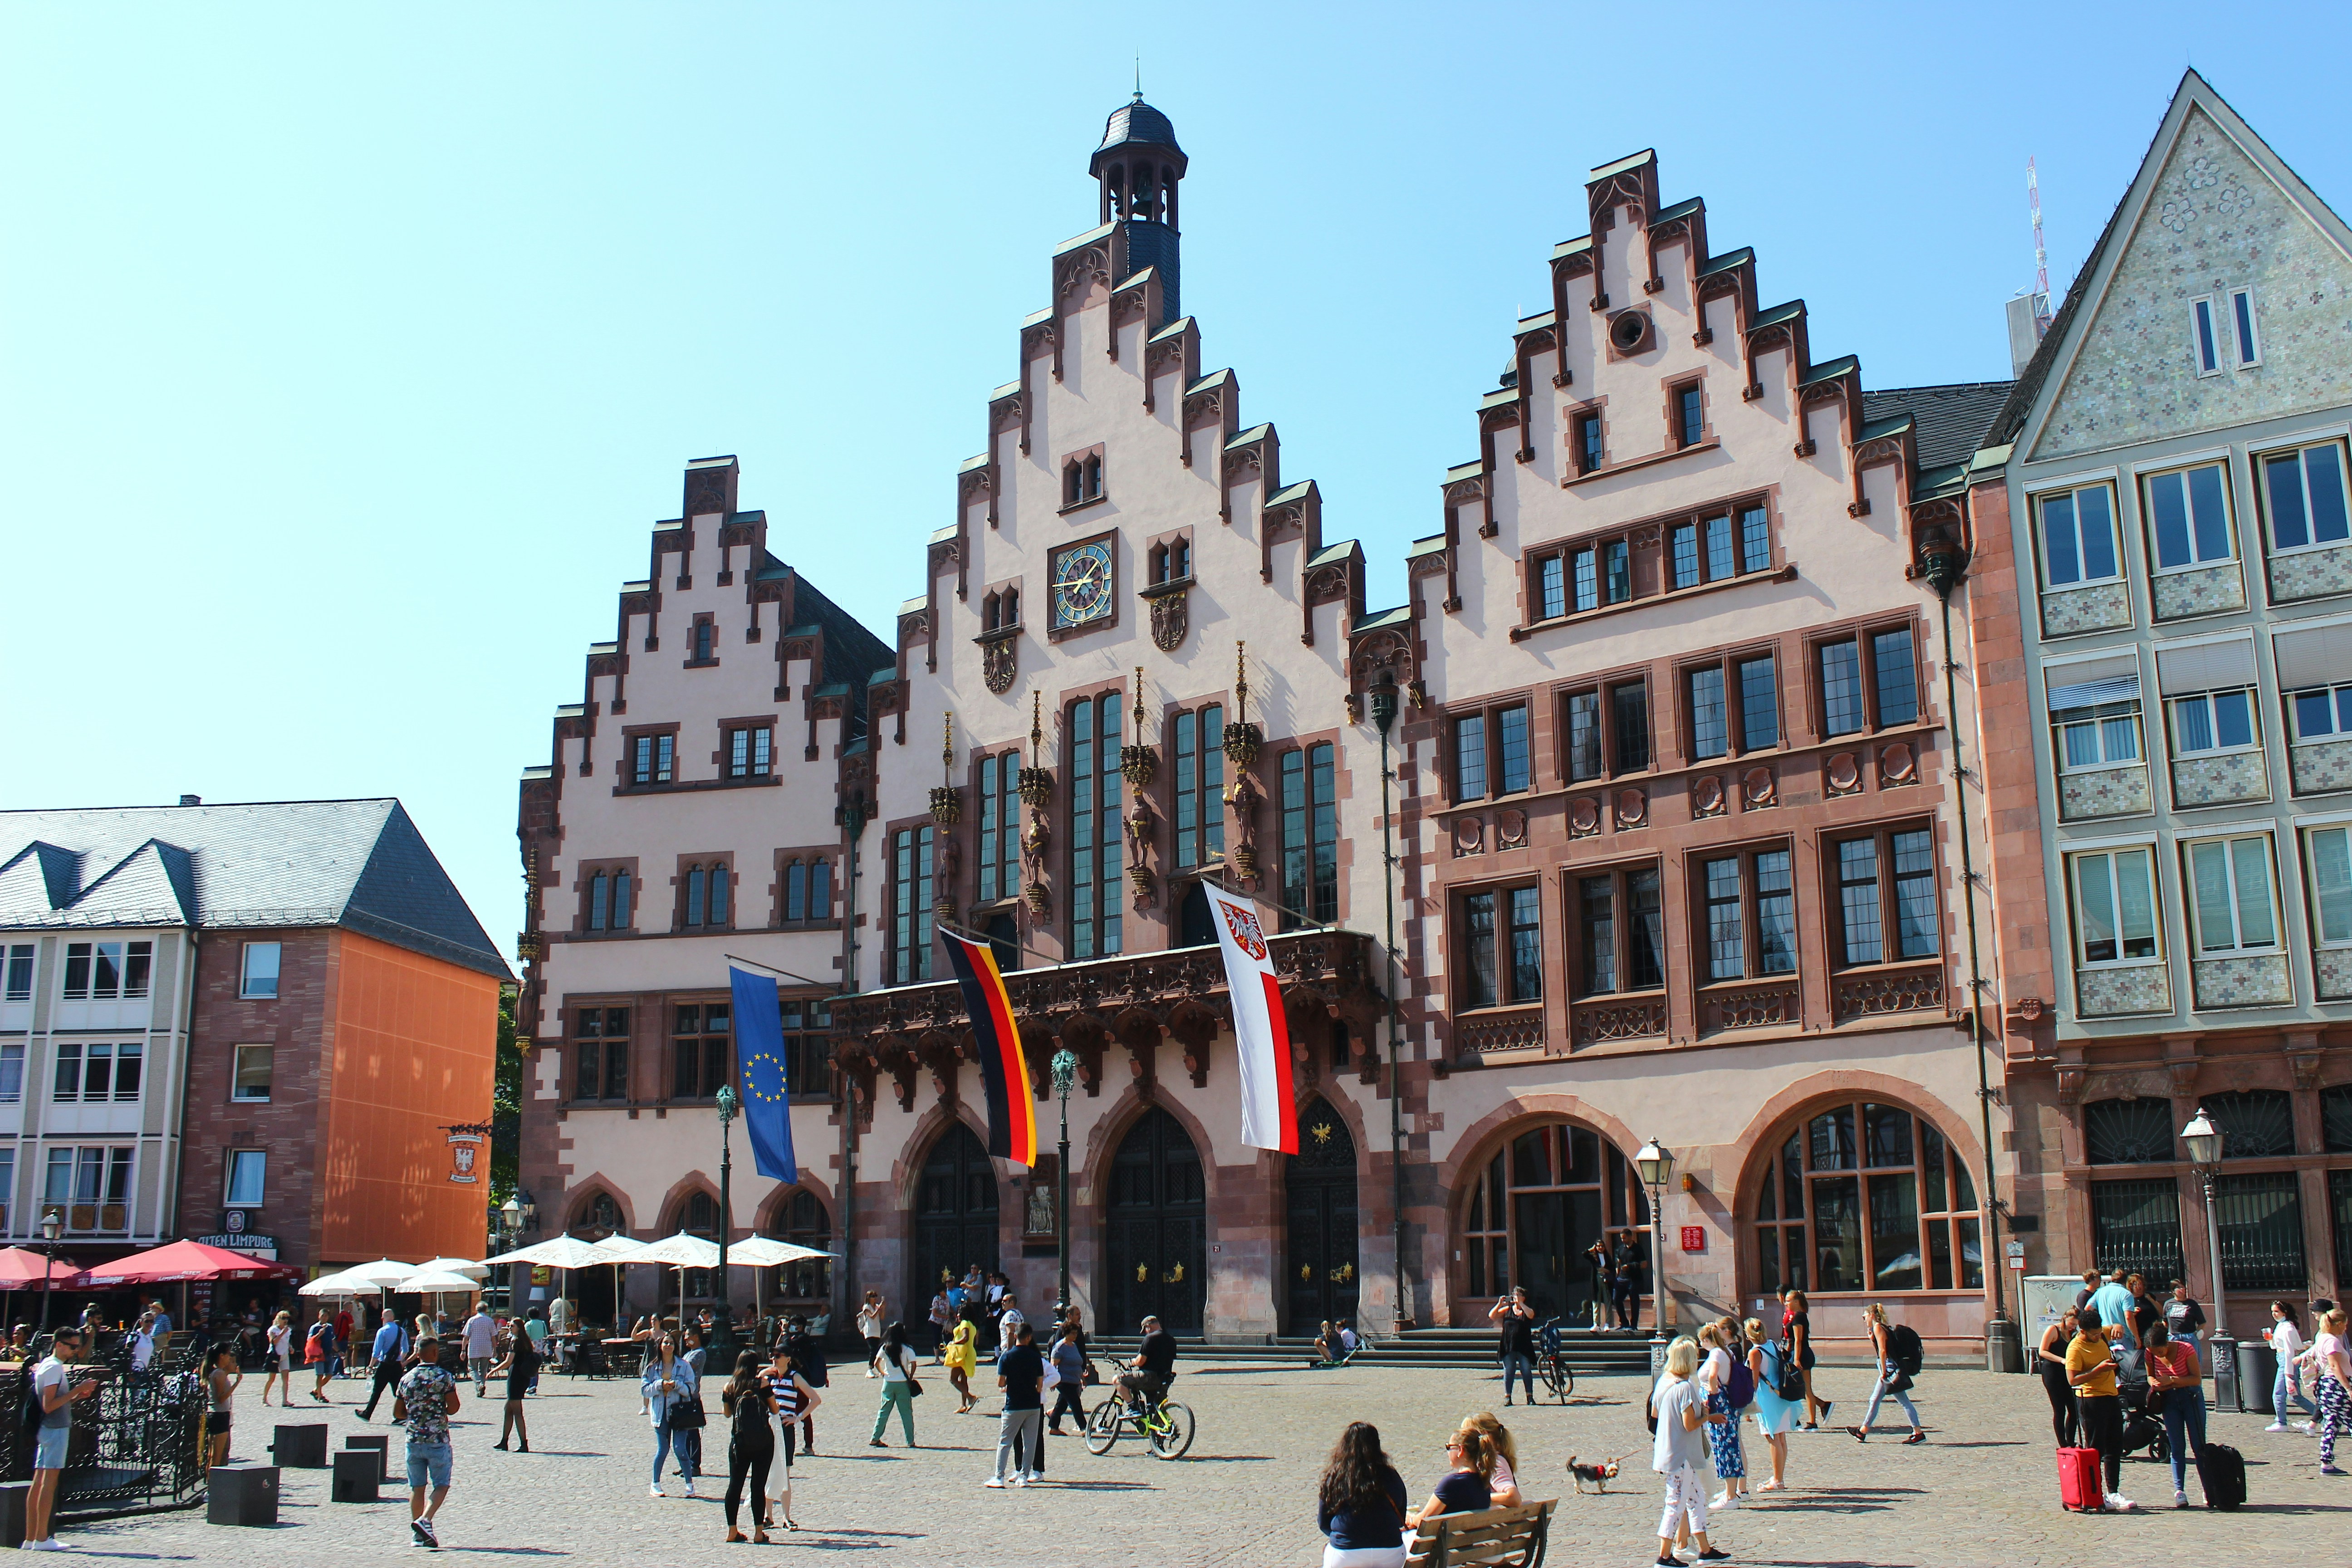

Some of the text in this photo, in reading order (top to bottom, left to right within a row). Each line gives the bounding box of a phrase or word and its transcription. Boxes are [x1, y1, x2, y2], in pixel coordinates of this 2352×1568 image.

[1068, 555, 1074, 564] XI
[1101, 557, 1108, 566] II
[198, 1234, 273, 1248] ALTEN LIMPURG
[90, 1275, 125, 1284] Henninger
